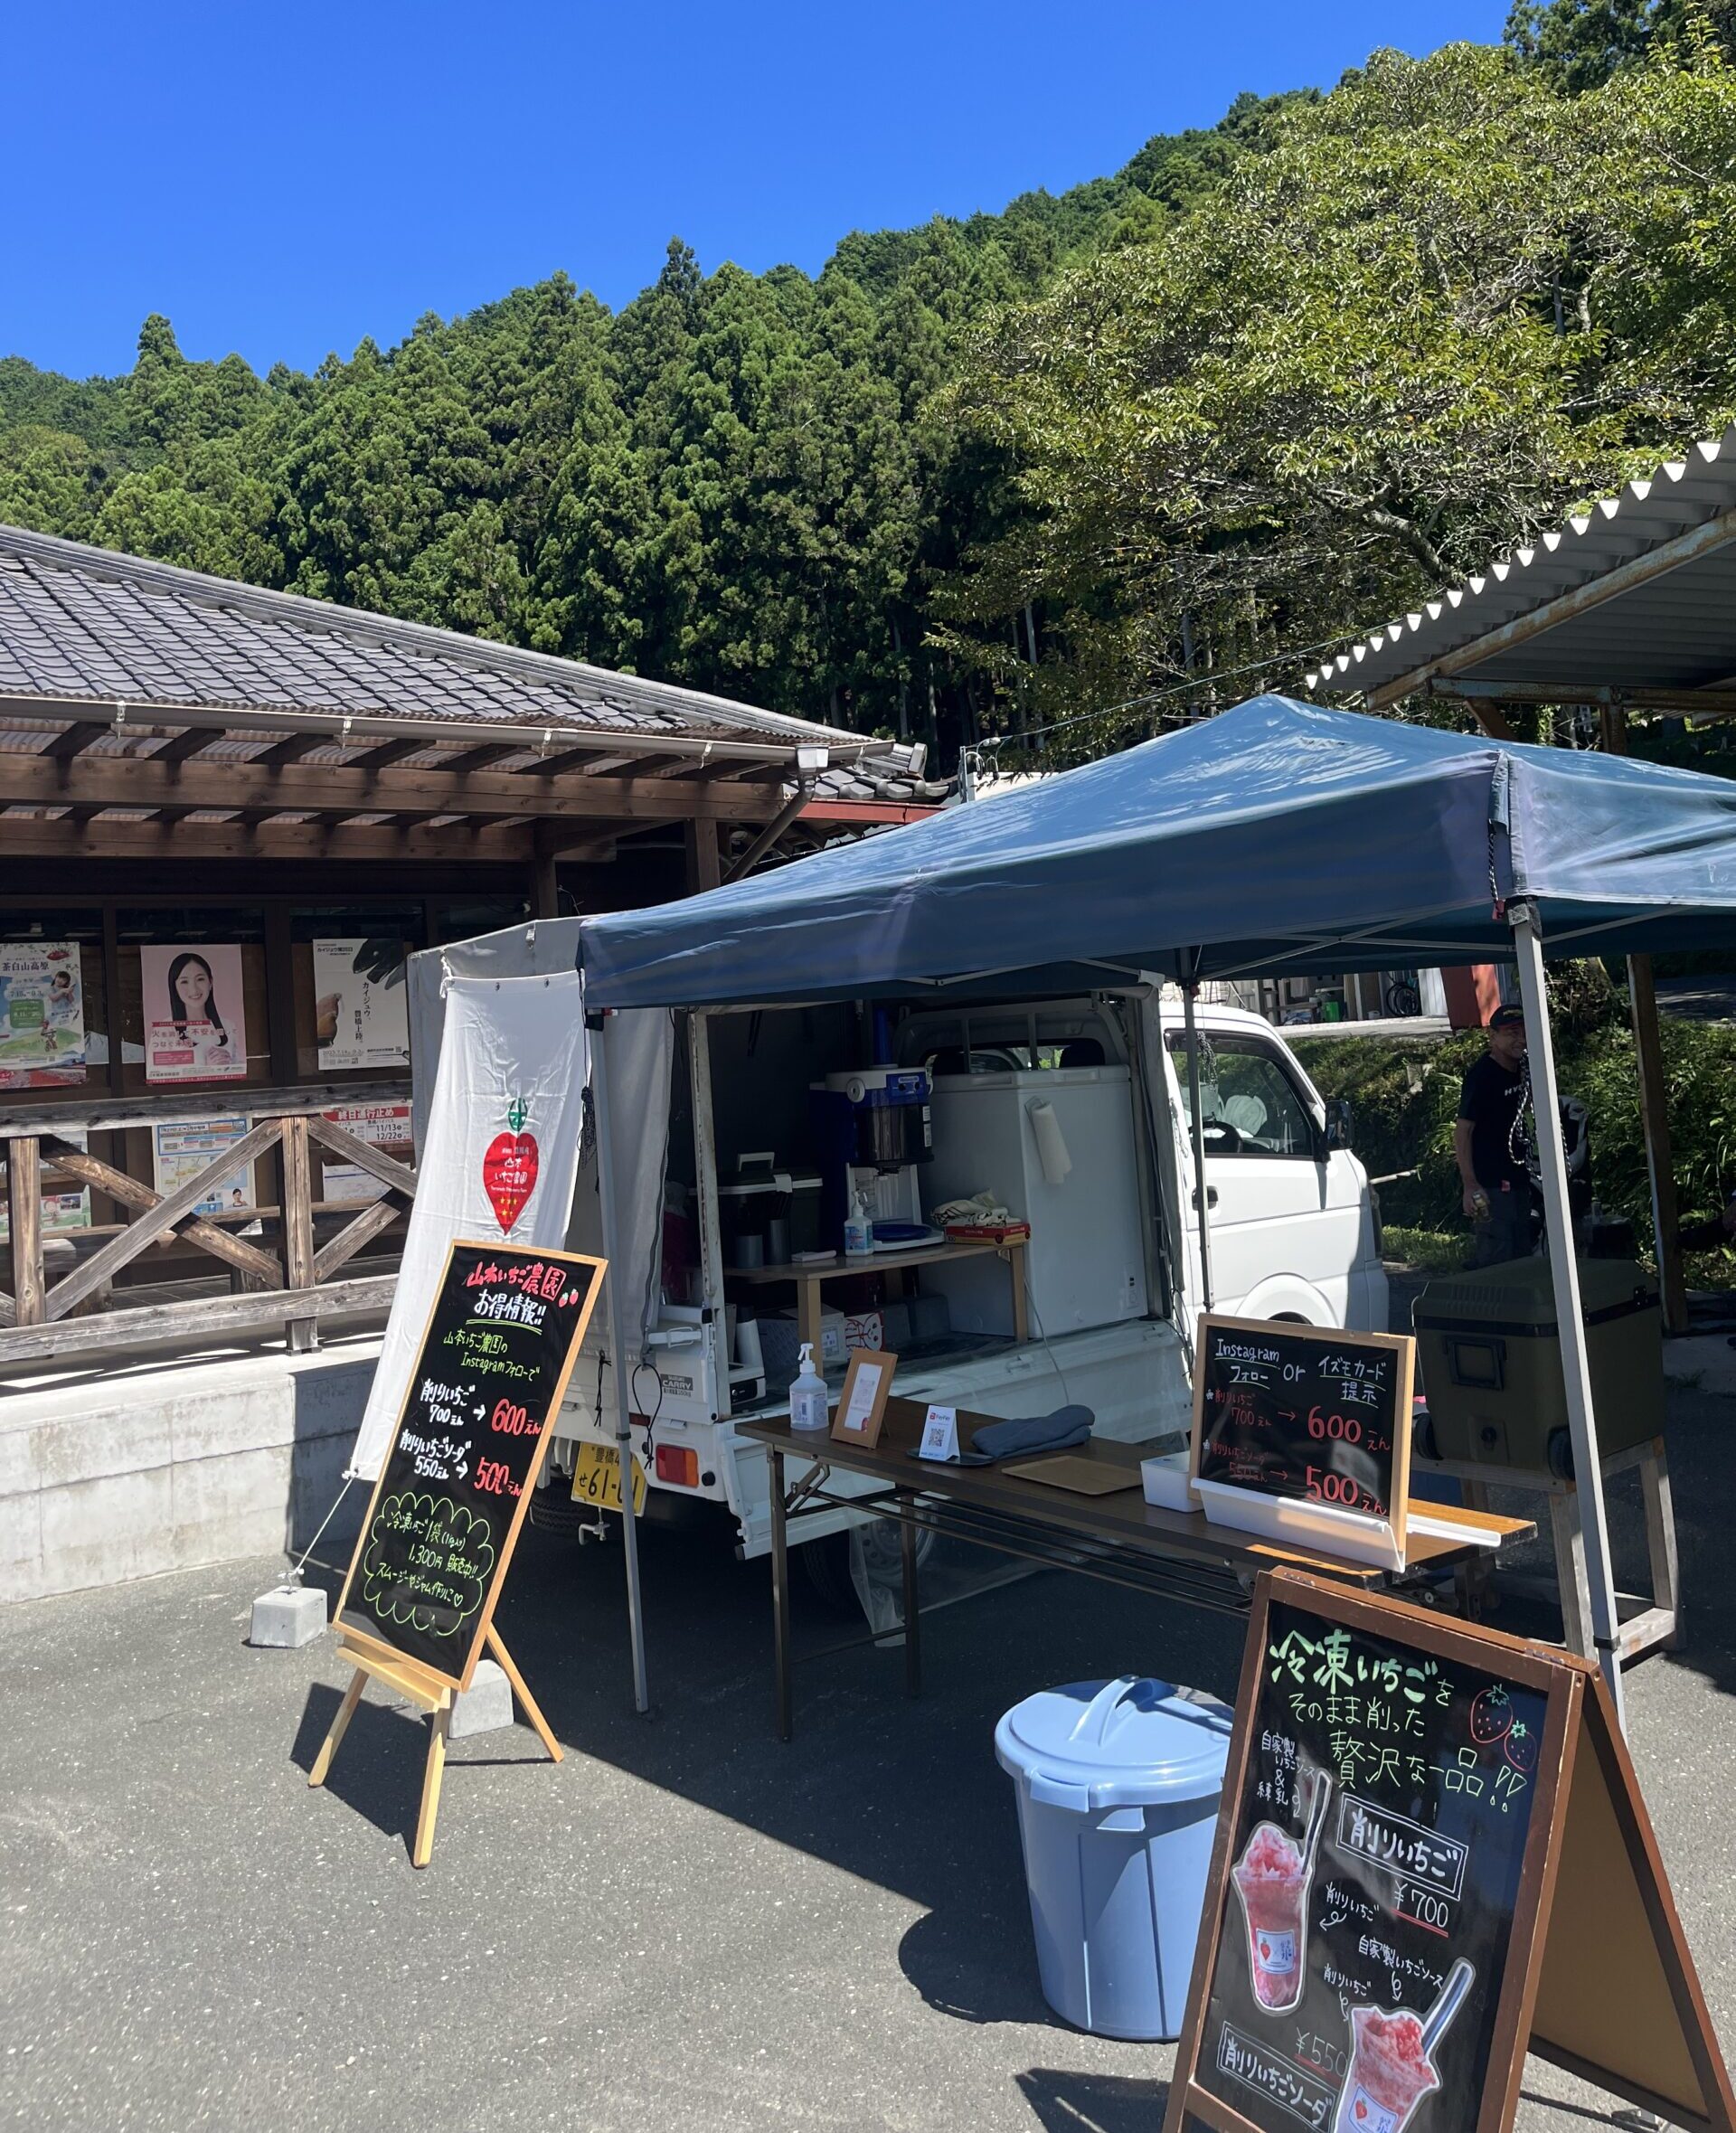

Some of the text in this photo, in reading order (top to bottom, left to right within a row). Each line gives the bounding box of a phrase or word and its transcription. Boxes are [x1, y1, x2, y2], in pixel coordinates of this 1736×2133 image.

[354, 1010, 364, 1043] 豊橋上陸。
[337, 1109, 394, 1120] 終日通行止め
[466, 1260, 567, 1302] 山本いちご農園
[443, 1328, 508, 1354] 山本いちご農園の
[1215, 1337, 1279, 1362] Instagram
[1229, 1364, 1269, 1383] フォロー
[1317, 1354, 1387, 1382] イズモカード
[420, 1378, 476, 1407] 削りいちご
[662, 1380, 692, 1390] CARRY
[1214, 1388, 1257, 1407] 削りいちご
[1341, 1381, 1377, 1403] 提示
[399, 1428, 473, 1463] 削りいちごソーダ
[579, 1472, 588, 1487] せ
[1288, 1692, 1425, 1737] そのまま削った
[1261, 1729, 1296, 1759] 自家製
[1274, 1769, 1285, 1788] &
[1275, 1755, 1316, 1779] いちごソース
[1257, 1780, 1288, 1806] 練乳
[1350, 1807, 1459, 1878] 削りいちご
[1325, 1881, 1380, 1922] 削りいちご
[1393, 1880, 1449, 1929] ¥700
[1358, 1934, 1444, 1990] 自家製いちごソース
[1323, 1963, 1373, 1997] 削りいちご
[1224, 2036, 1334, 2127] 削りいちごソーダ
